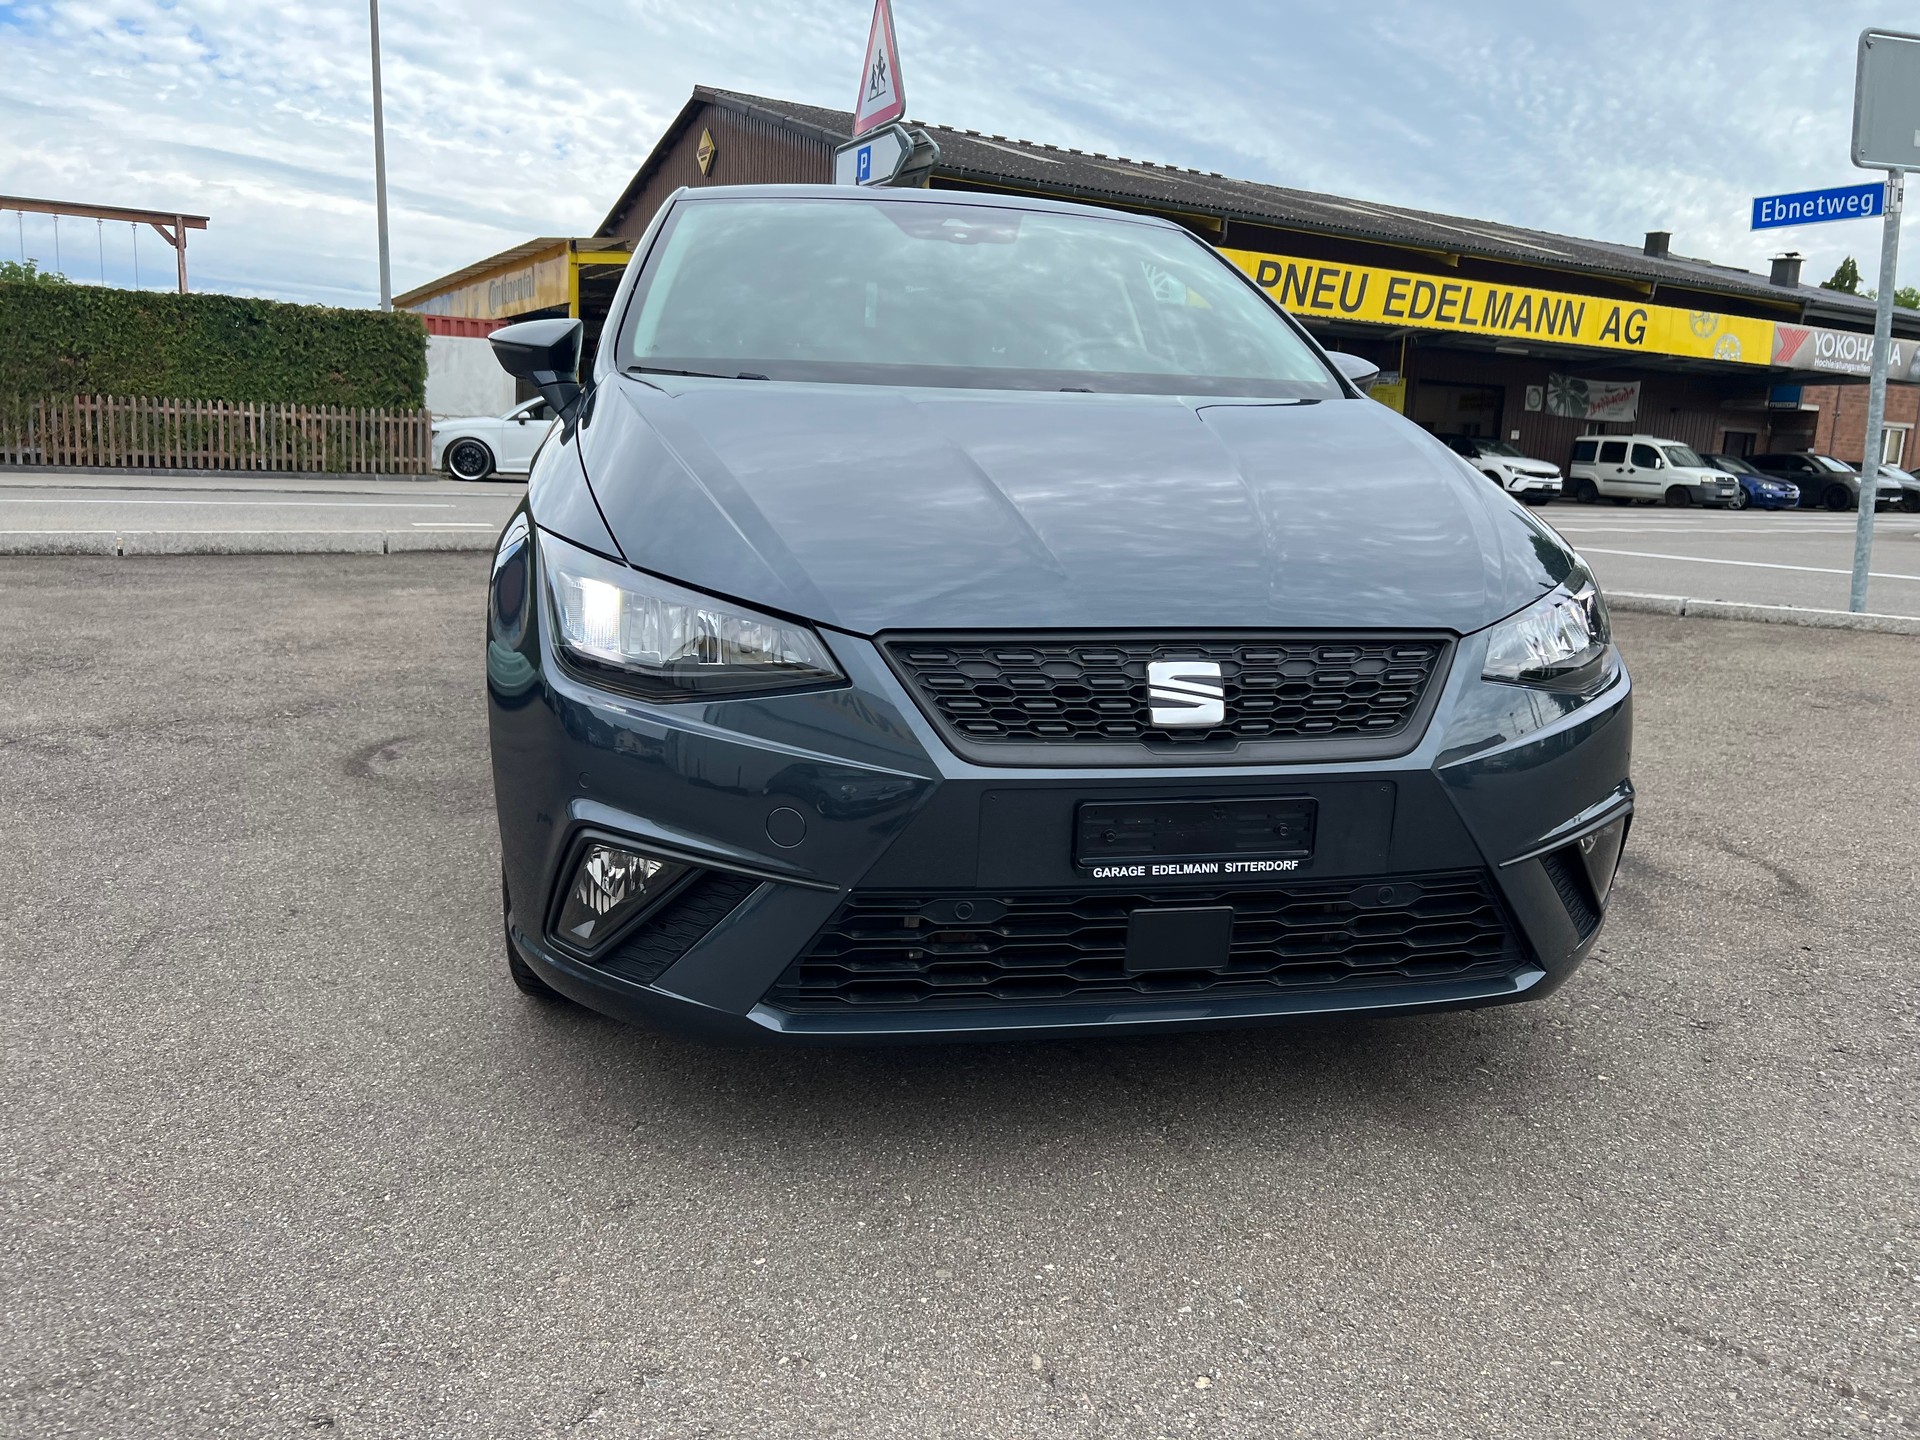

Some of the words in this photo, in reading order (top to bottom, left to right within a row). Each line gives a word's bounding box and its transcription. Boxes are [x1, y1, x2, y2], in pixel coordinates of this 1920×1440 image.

[860, 152, 868, 178] P
[1761, 192, 1874, 222] Ebnetweg
[488, 265, 535, 316] Continental
[1256, 259, 1369, 313] PNEU
[1382, 276, 1586, 338] EDELMANN
[1599, 306, 1648, 345] AG
[1093, 866, 1146, 878] GARAGE
[1152, 863, 1219, 875] EDELMANN
[1224, 860, 1299, 873] SITTERDORF
